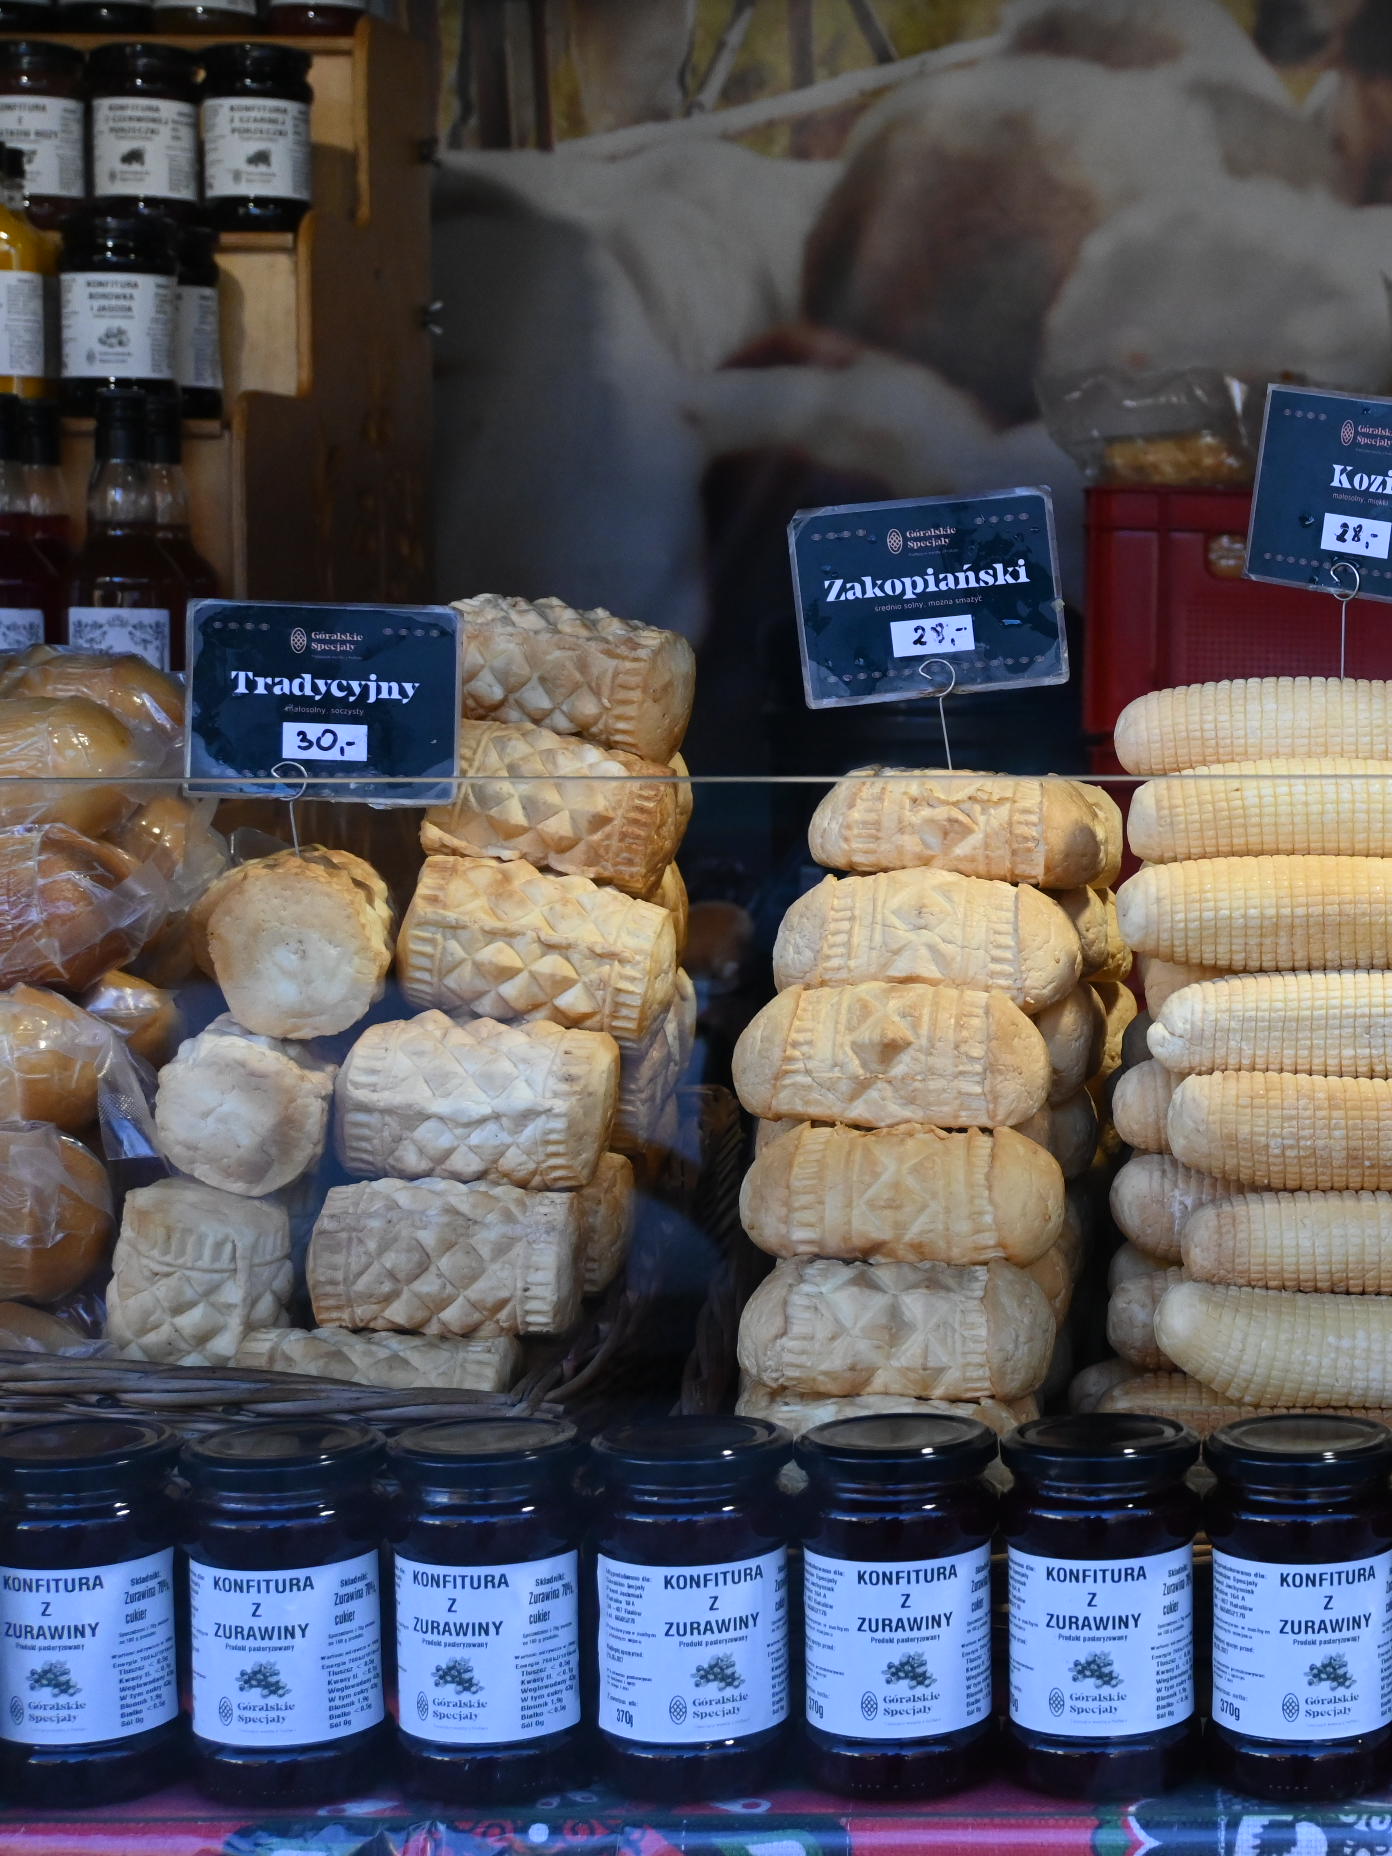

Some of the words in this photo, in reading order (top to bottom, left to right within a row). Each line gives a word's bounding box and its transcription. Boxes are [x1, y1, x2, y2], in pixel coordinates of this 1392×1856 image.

[906, 525, 956, 538] Góralskie
[824, 559, 1030, 602] Zakopiański
[311, 630, 363, 641] Góralskie
[231, 671, 420, 704] Tradycyjny
[413, 1570, 509, 1590] KONFITURA
[664, 1565, 763, 1590] KONFITURA
[857, 1565, 957, 1585] KONFITURA
[1046, 1566, 1147, 1583] KONFITURA
[1280, 1566, 1376, 1588] KONFITURA
[3, 1575, 104, 1593] KONFITURA
[213, 1576, 314, 1593] KONFITURA
[448, 1598, 457, 1612] Z
[709, 1596, 719, 1610] Z
[901, 1594, 911, 1608] Z
[1087, 1593, 1097, 1607] Z
[1324, 1596, 1333, 1610] Z
[41, 1602, 52, 1616] Z
[125, 1608, 148, 1624] cukier
[252, 1603, 262, 1617] Z
[335, 1609, 356, 1626] cukier
[529, 1610, 550, 1624] cukier
[433, 1698, 487, 1708] Góralskie
[693, 1692, 748, 1707] Góralskie
[883, 1692, 941, 1704] Góralskie
[1070, 1692, 1127, 1702] Góralskie
[1305, 1693, 1360, 1706] Góralskie
[28, 1702, 86, 1711] Góralskie
[238, 1702, 295, 1711] Góralskie
[1220, 1698, 1240, 1721] 370g
[617, 1708, 633, 1728] 370g
